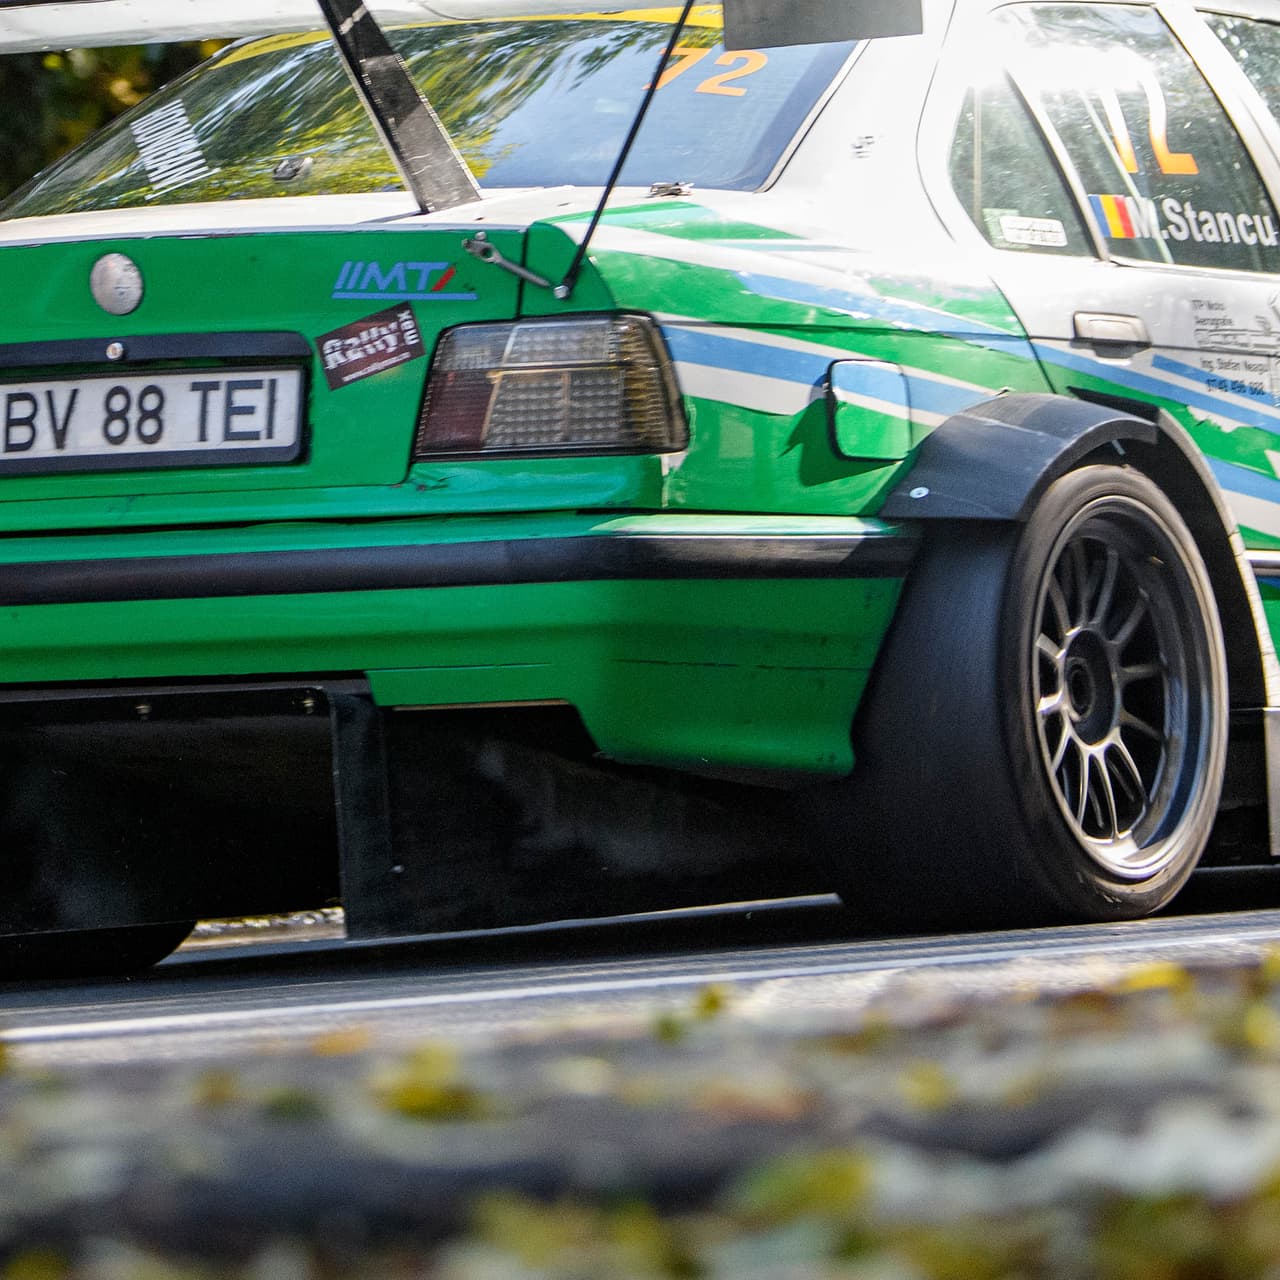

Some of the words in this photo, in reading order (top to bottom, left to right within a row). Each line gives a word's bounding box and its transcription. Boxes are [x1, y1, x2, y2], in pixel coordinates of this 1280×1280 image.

[641, 47, 769, 97] 72
[3, 387, 80, 454] BV
[102, 384, 167, 446] 88
[189, 377, 279, 443] TEI
